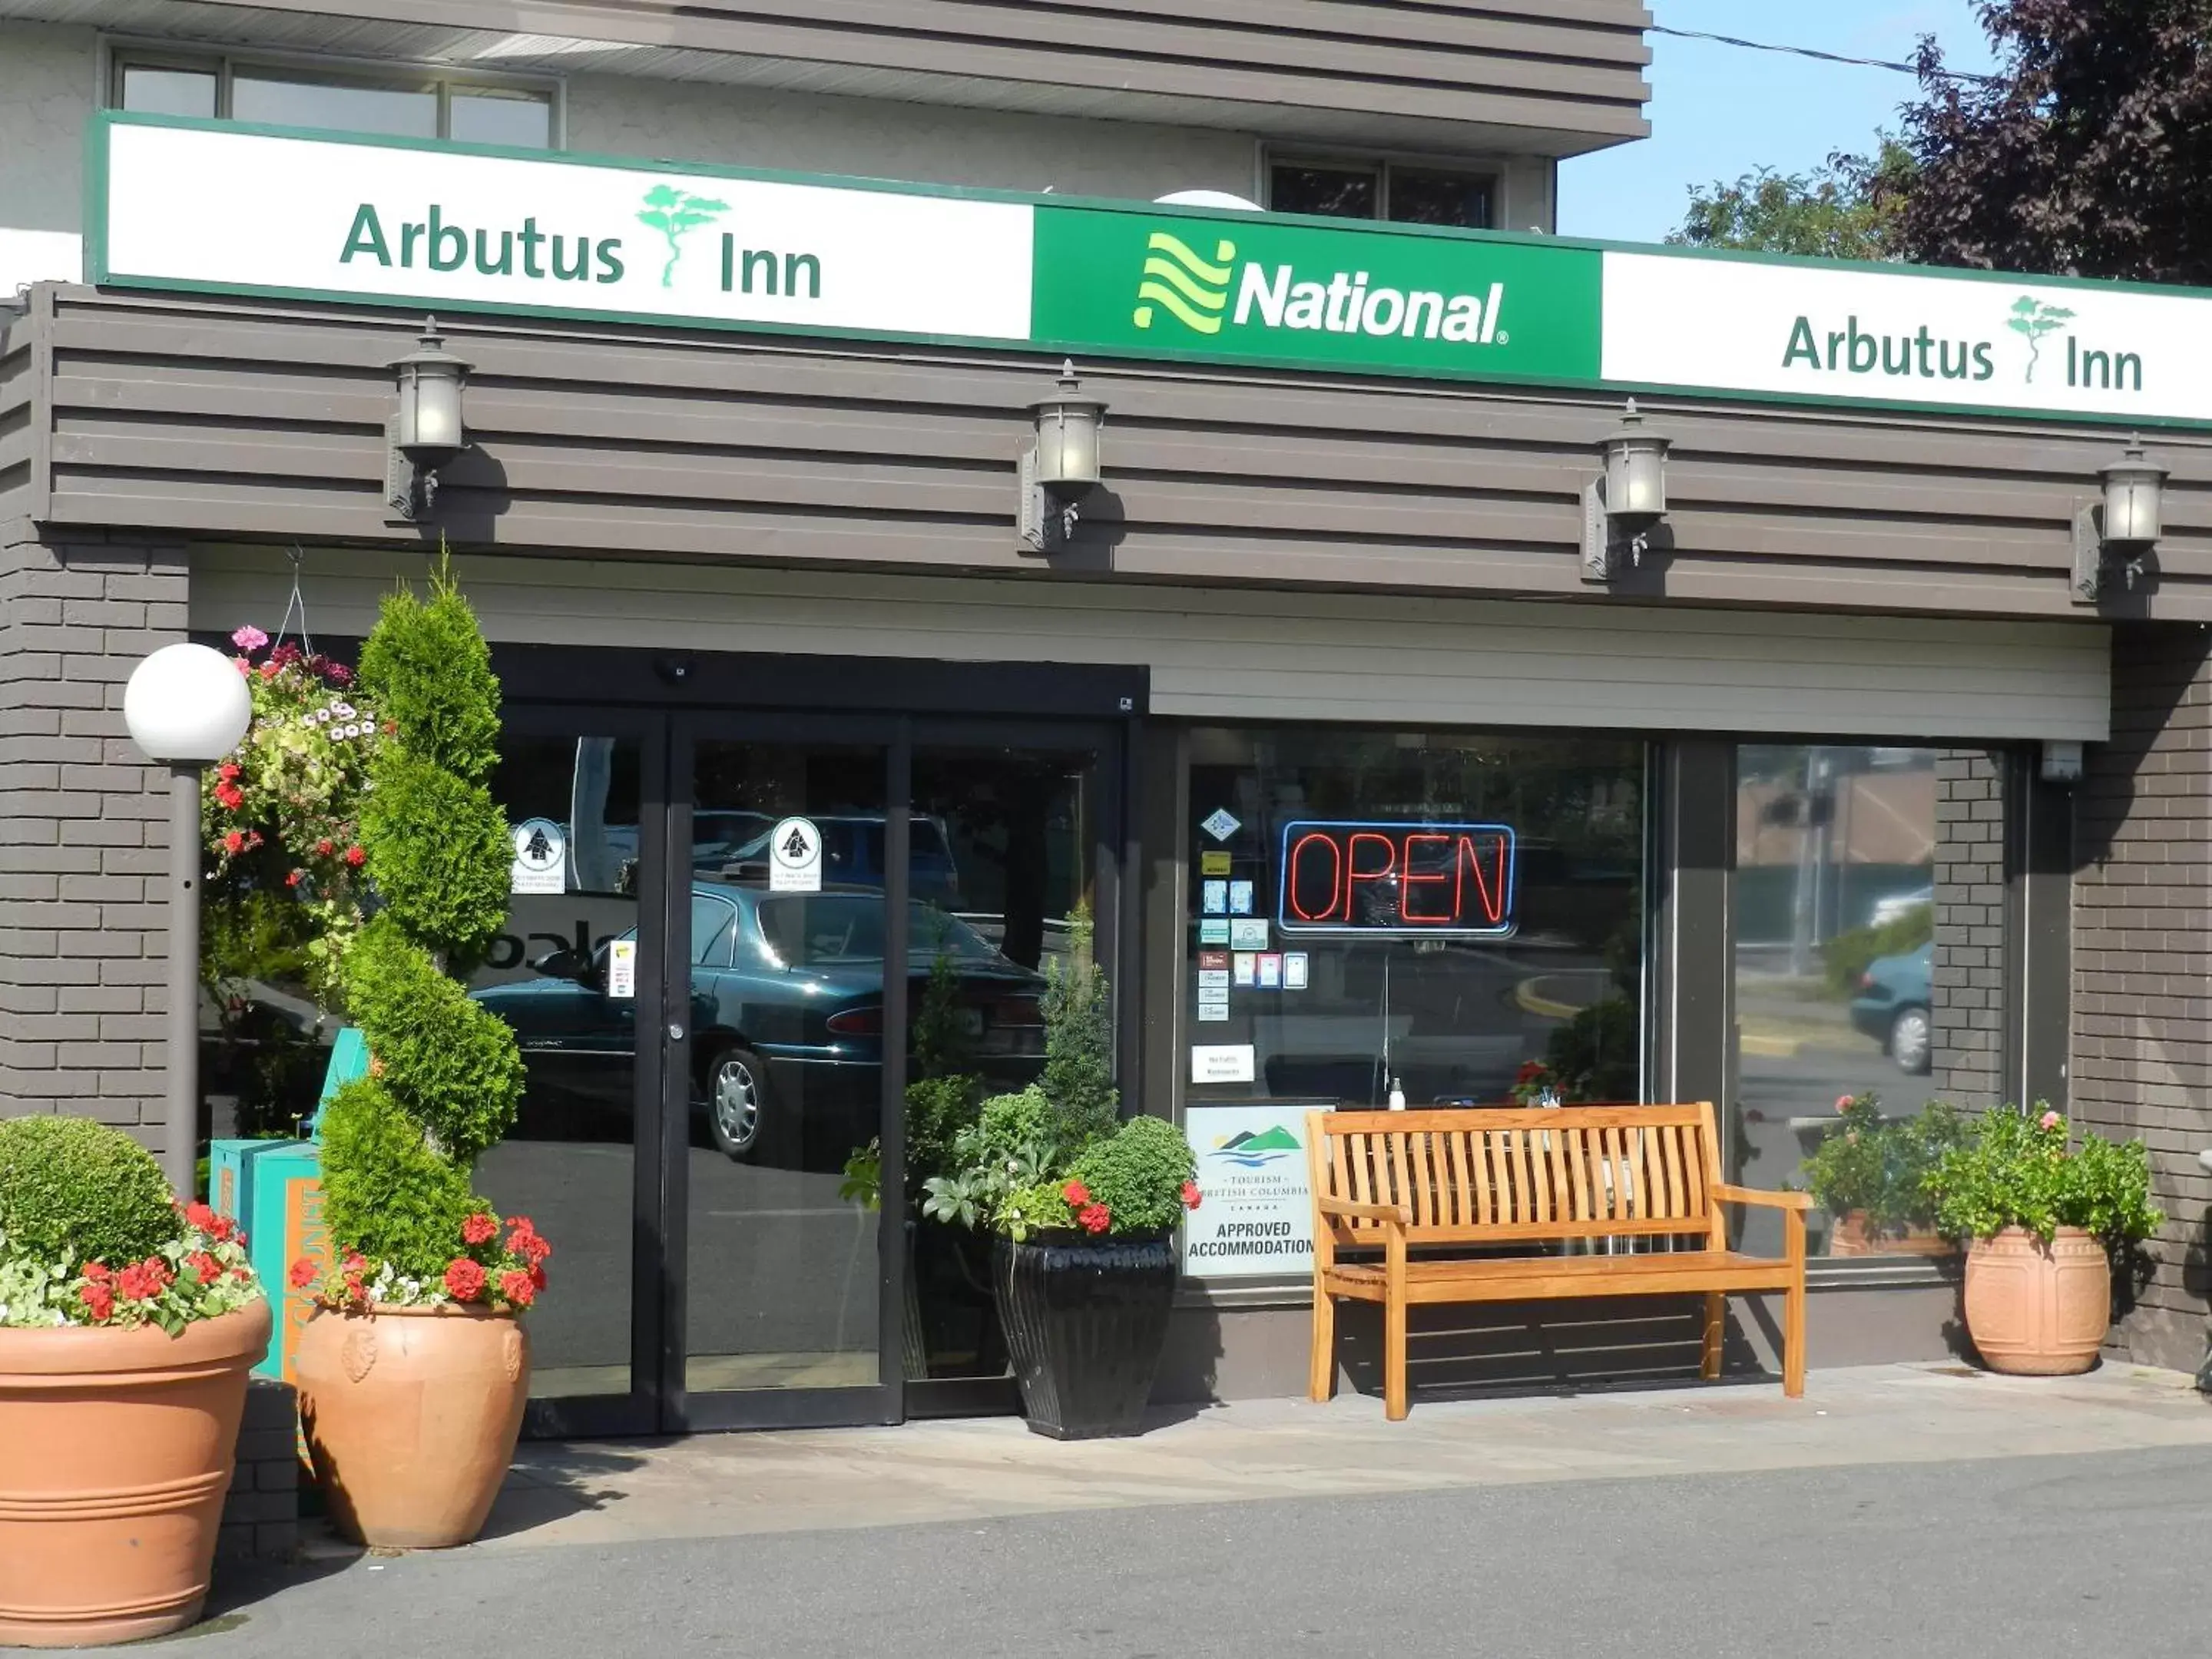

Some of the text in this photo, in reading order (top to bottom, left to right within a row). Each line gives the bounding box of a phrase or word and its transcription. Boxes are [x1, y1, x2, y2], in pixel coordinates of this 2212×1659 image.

[339, 204, 820, 298] Arbutus Inn
[1233, 262, 1503, 344] National
[1782, 316, 2142, 391] Arbutus Inn
[1291, 833, 1503, 922] OPEN
[1232, 1176, 1281, 1184] TOURISM
[1188, 1240, 1314, 1257] ACCOMMODATION
[1217, 1222, 1291, 1237] APPROVED
